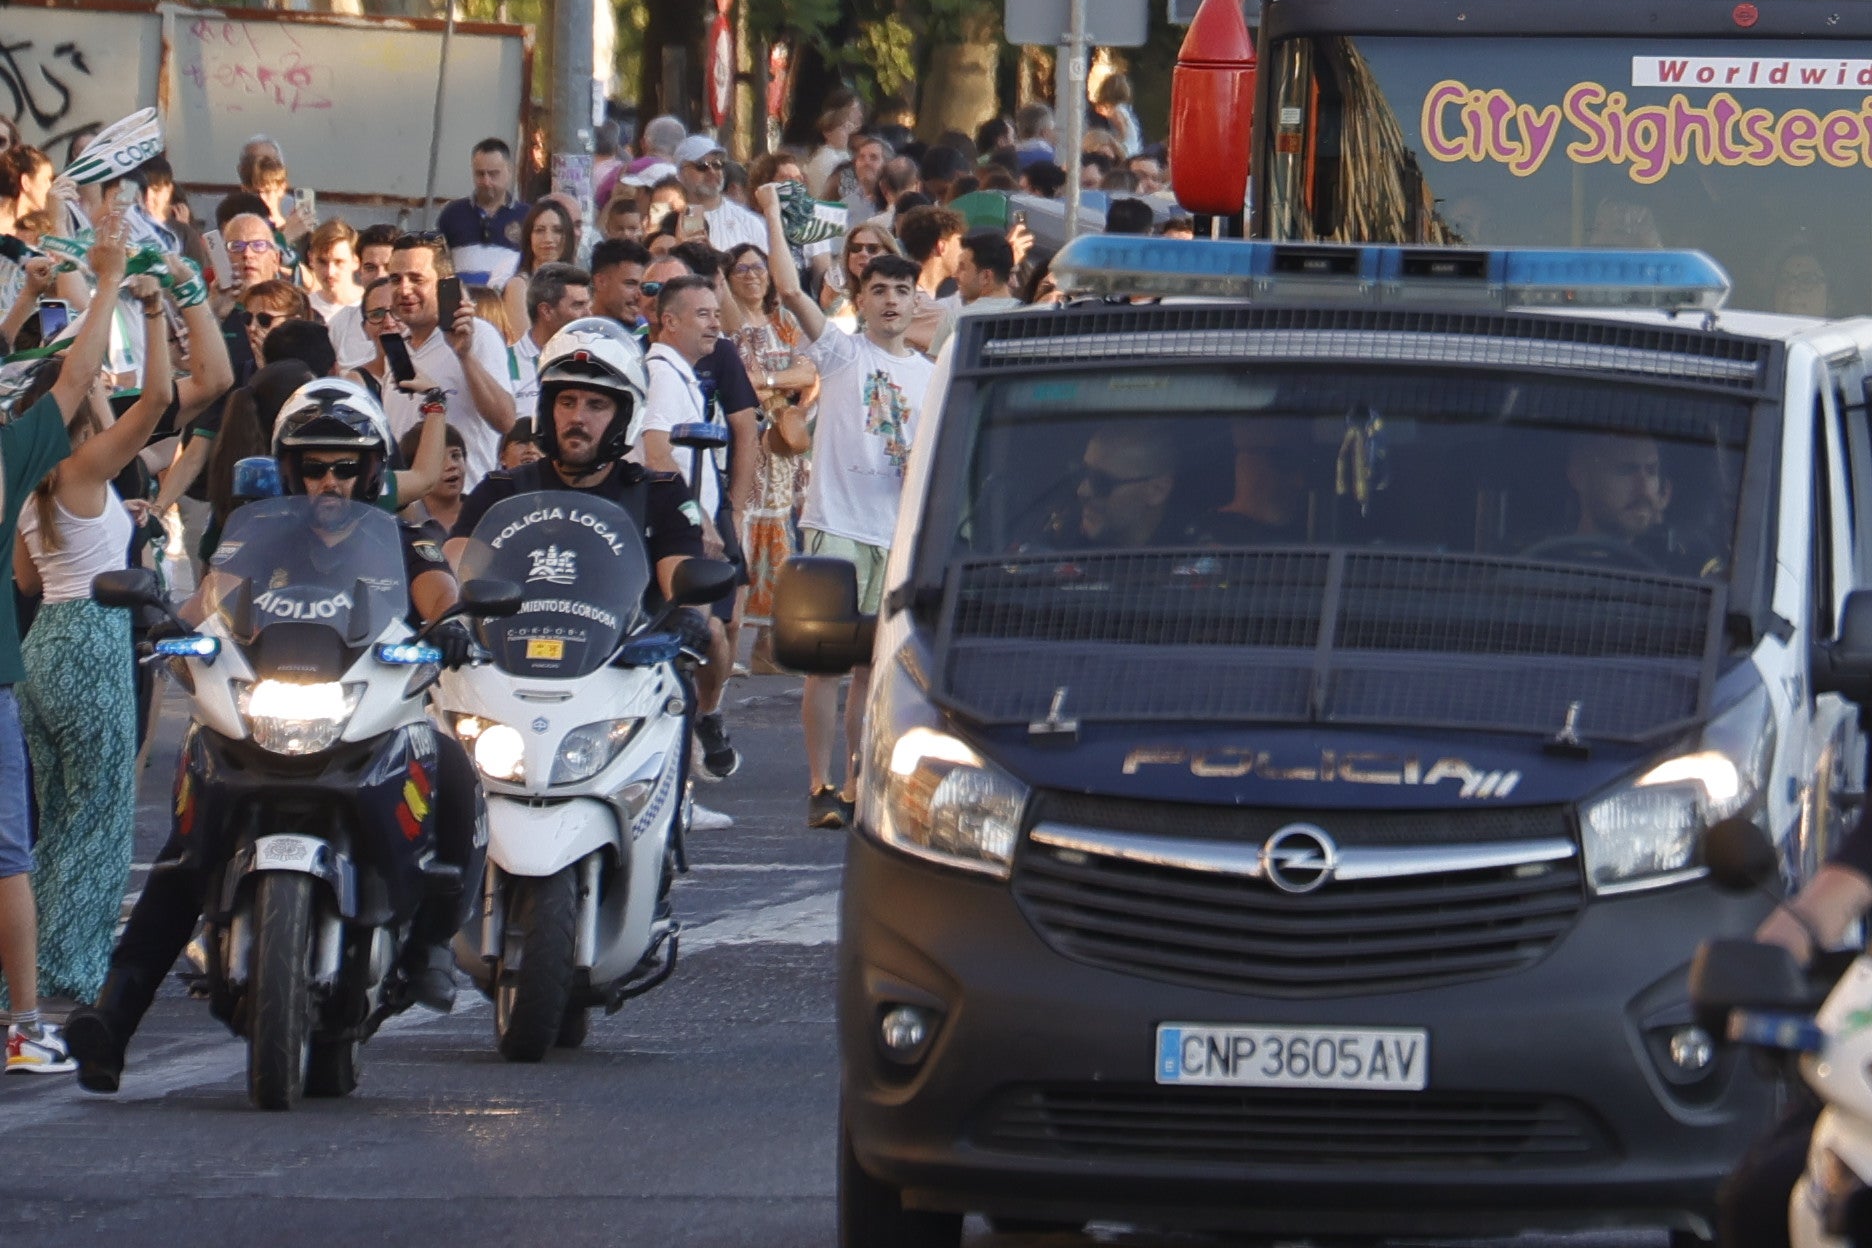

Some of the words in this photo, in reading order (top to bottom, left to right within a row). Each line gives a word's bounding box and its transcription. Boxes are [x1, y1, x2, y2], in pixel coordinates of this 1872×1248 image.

[1421, 79, 1559, 176] City
[569, 510, 625, 557] LOCAL
[559, 600, 571, 614] DE
[1122, 748, 1480, 797] POLICIA
